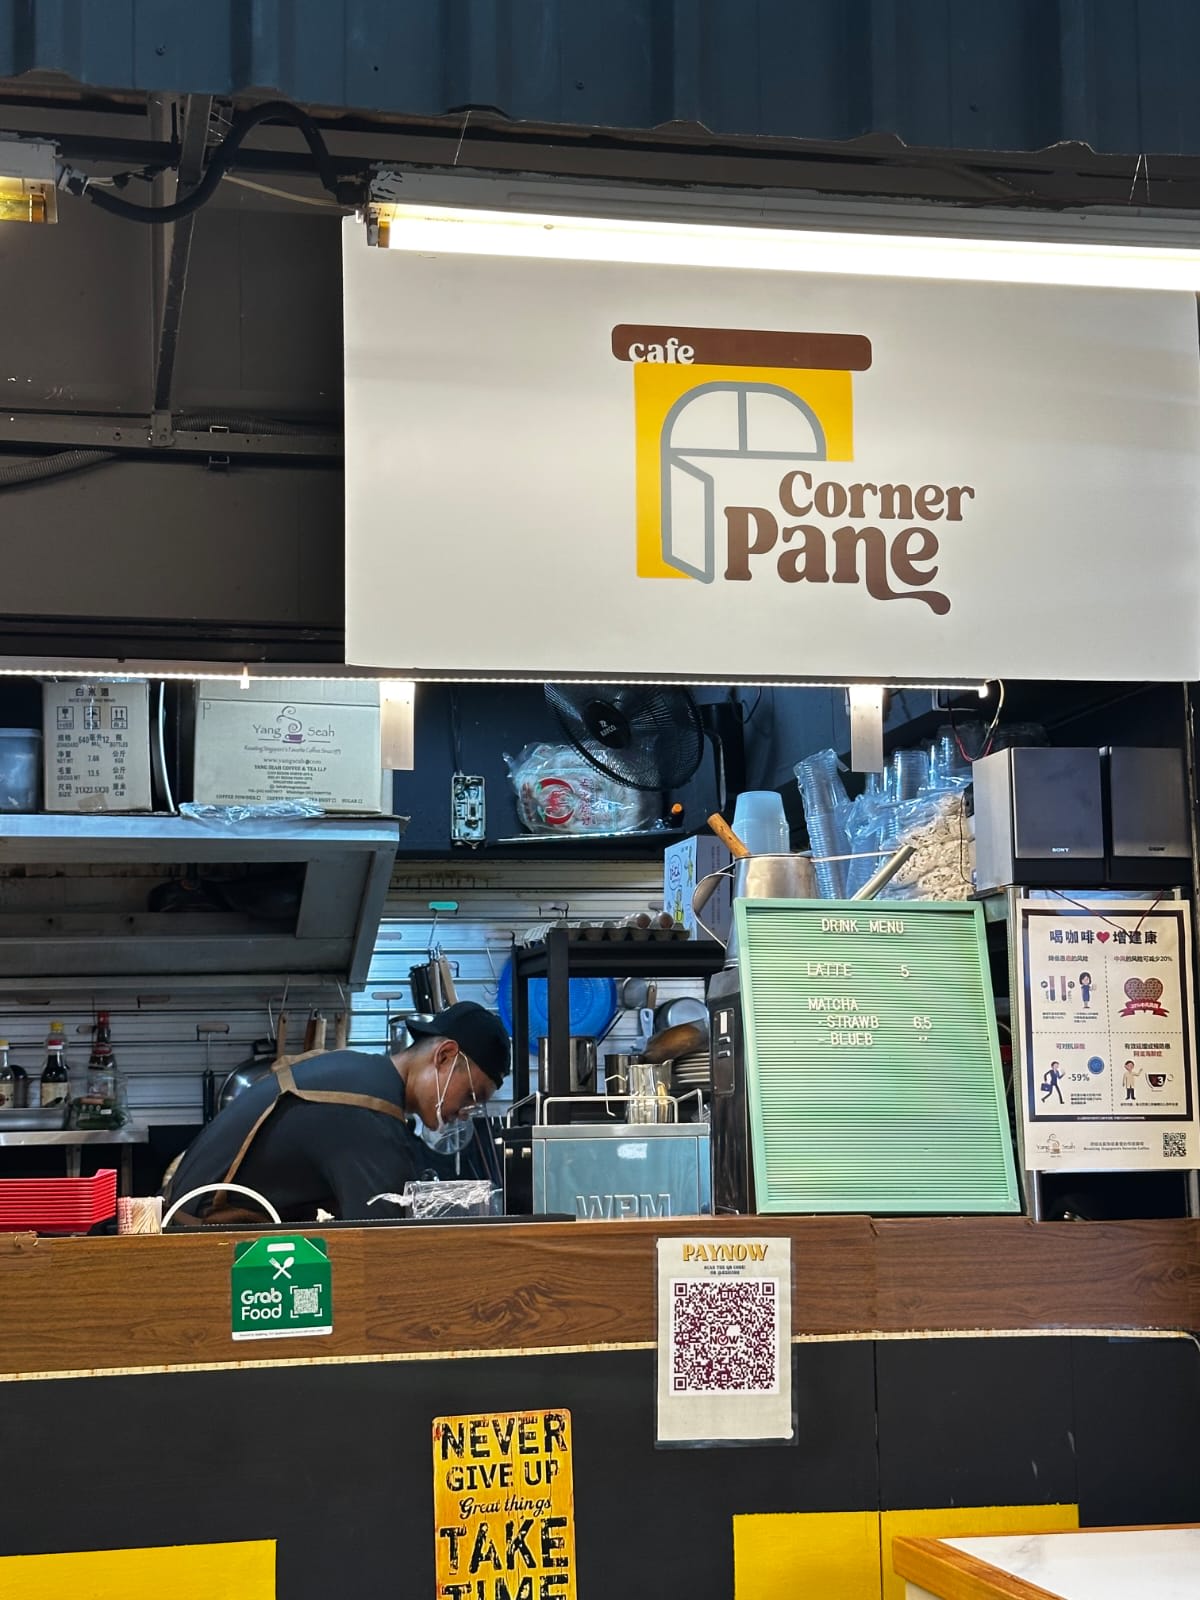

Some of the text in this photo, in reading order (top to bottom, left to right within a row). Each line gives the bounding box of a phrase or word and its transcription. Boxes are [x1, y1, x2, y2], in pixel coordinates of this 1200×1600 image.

[628, 337, 695, 364] cafe
[779, 470, 975, 521] Corner
[724, 506, 951, 615] Pane
[252, 723, 335, 739] Yang Seah
[821, 918, 904, 934] DRINK MENU
[1049, 929, 1158, 944] 喝咖啡 增健康
[807, 962, 910, 978] LATTE 5
[808, 997, 859, 1011] MATCHA
[1068, 1073, 1090, 1082] -59%
[575, 1193, 671, 1219] WPM
[682, 1243, 769, 1262] PAYNOW
[240, 1287, 283, 1305] Grab
[241, 1303, 282, 1321] Food
[709, 1326, 729, 1335] PAY
[441, 1413, 568, 1460] NEVER
[446, 1459, 559, 1492] GIVE UP
[459, 1494, 552, 1520] Great things
[439, 1516, 569, 1575] TAKE
